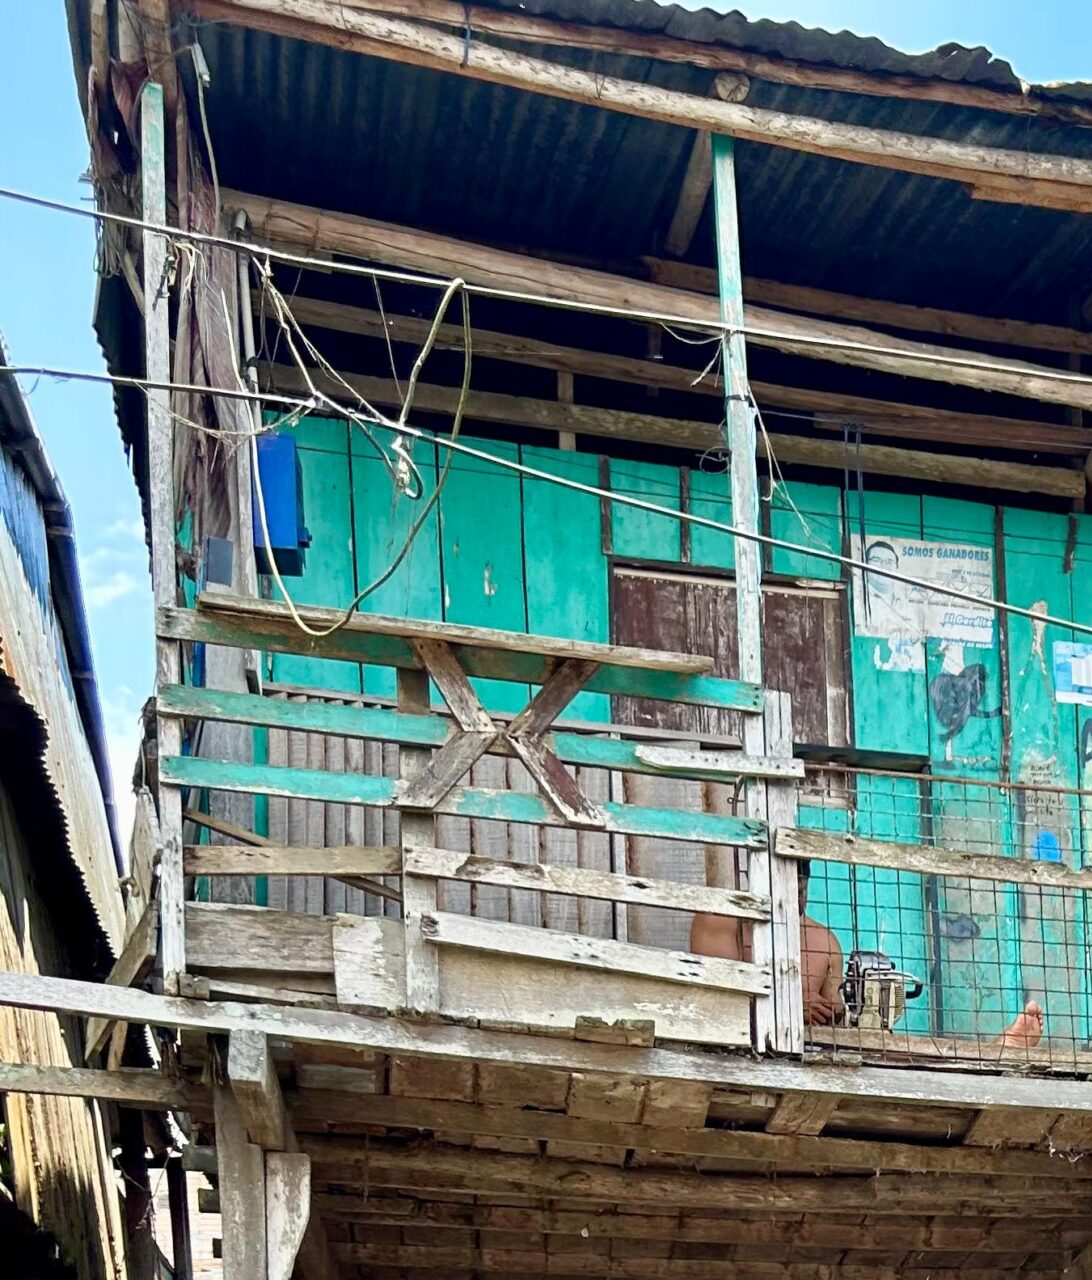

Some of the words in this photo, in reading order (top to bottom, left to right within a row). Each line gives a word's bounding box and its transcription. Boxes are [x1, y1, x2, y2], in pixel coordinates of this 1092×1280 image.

[902, 546, 934, 558] SOMOS
[936, 548, 990, 562] GANADORES
[944, 611, 955, 624] El
[956, 614, 993, 628] Gordito
